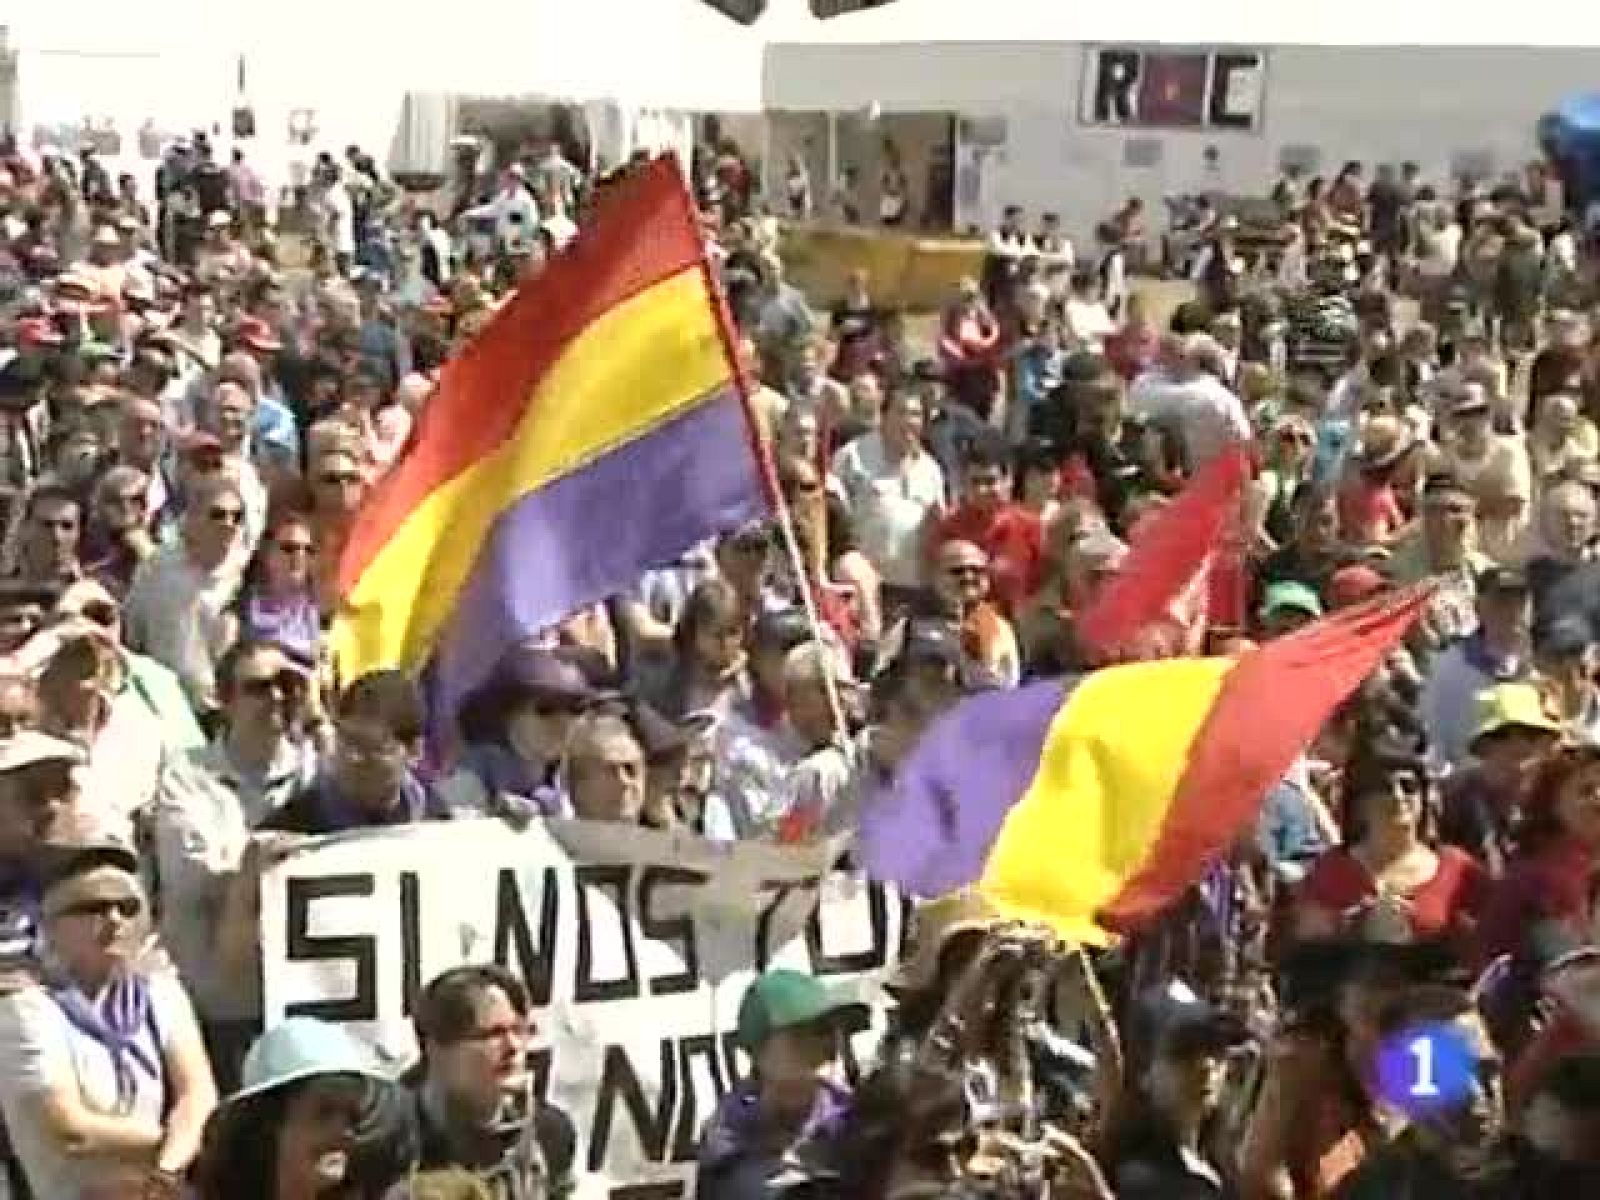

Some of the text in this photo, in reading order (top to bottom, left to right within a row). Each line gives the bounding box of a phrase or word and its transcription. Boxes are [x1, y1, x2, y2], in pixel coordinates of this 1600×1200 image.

[284, 866, 912, 1019] SI NOS TO
